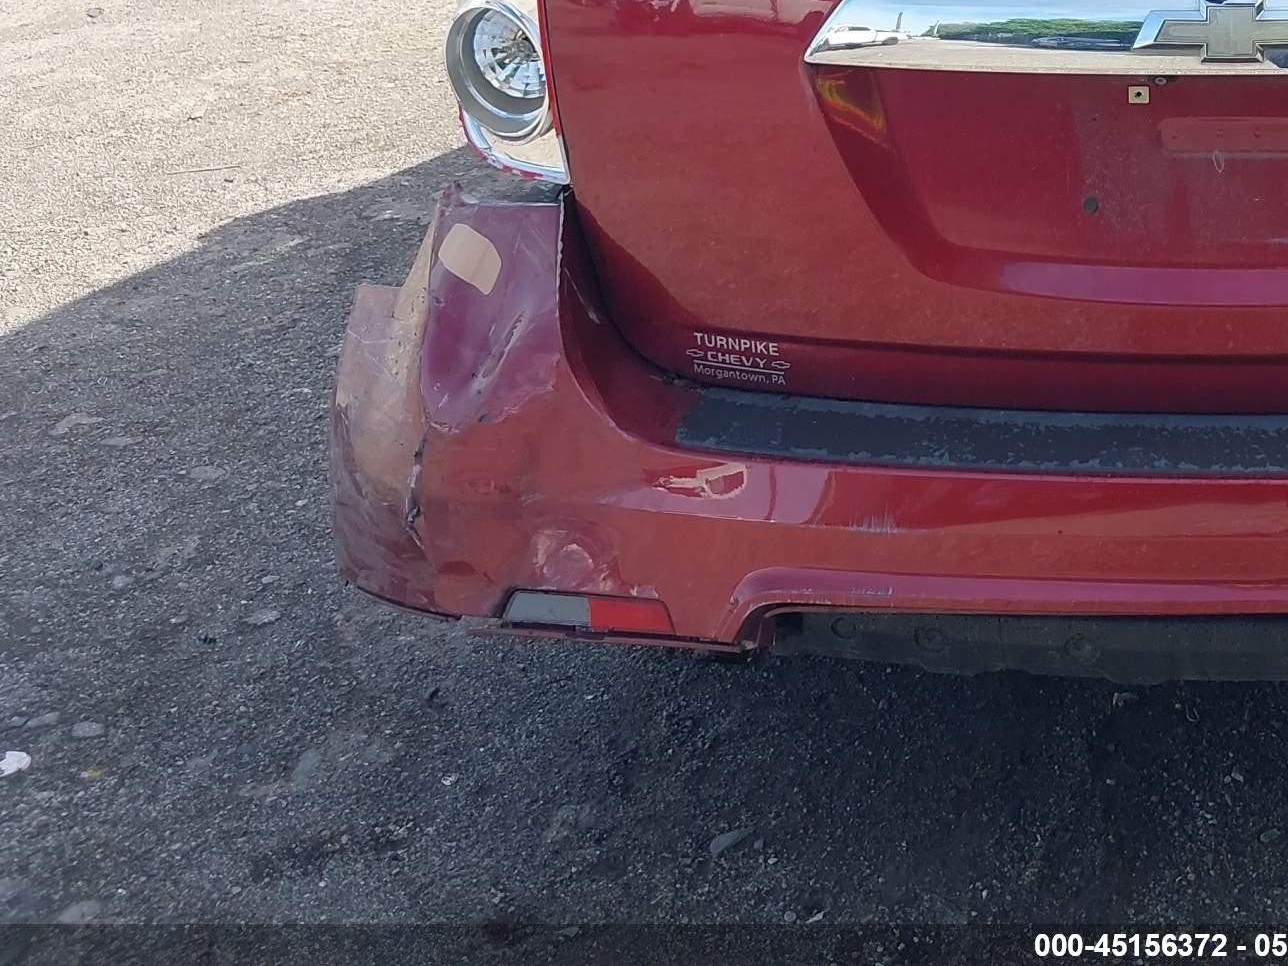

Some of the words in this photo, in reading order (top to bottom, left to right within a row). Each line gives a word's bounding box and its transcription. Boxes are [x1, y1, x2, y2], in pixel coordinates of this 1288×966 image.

[693, 332, 780, 356] TURNPIKE
[706, 351, 768, 368] CHEVY
[693, 363, 770, 384] Morgantown,
[772, 374, 786, 385] PA
